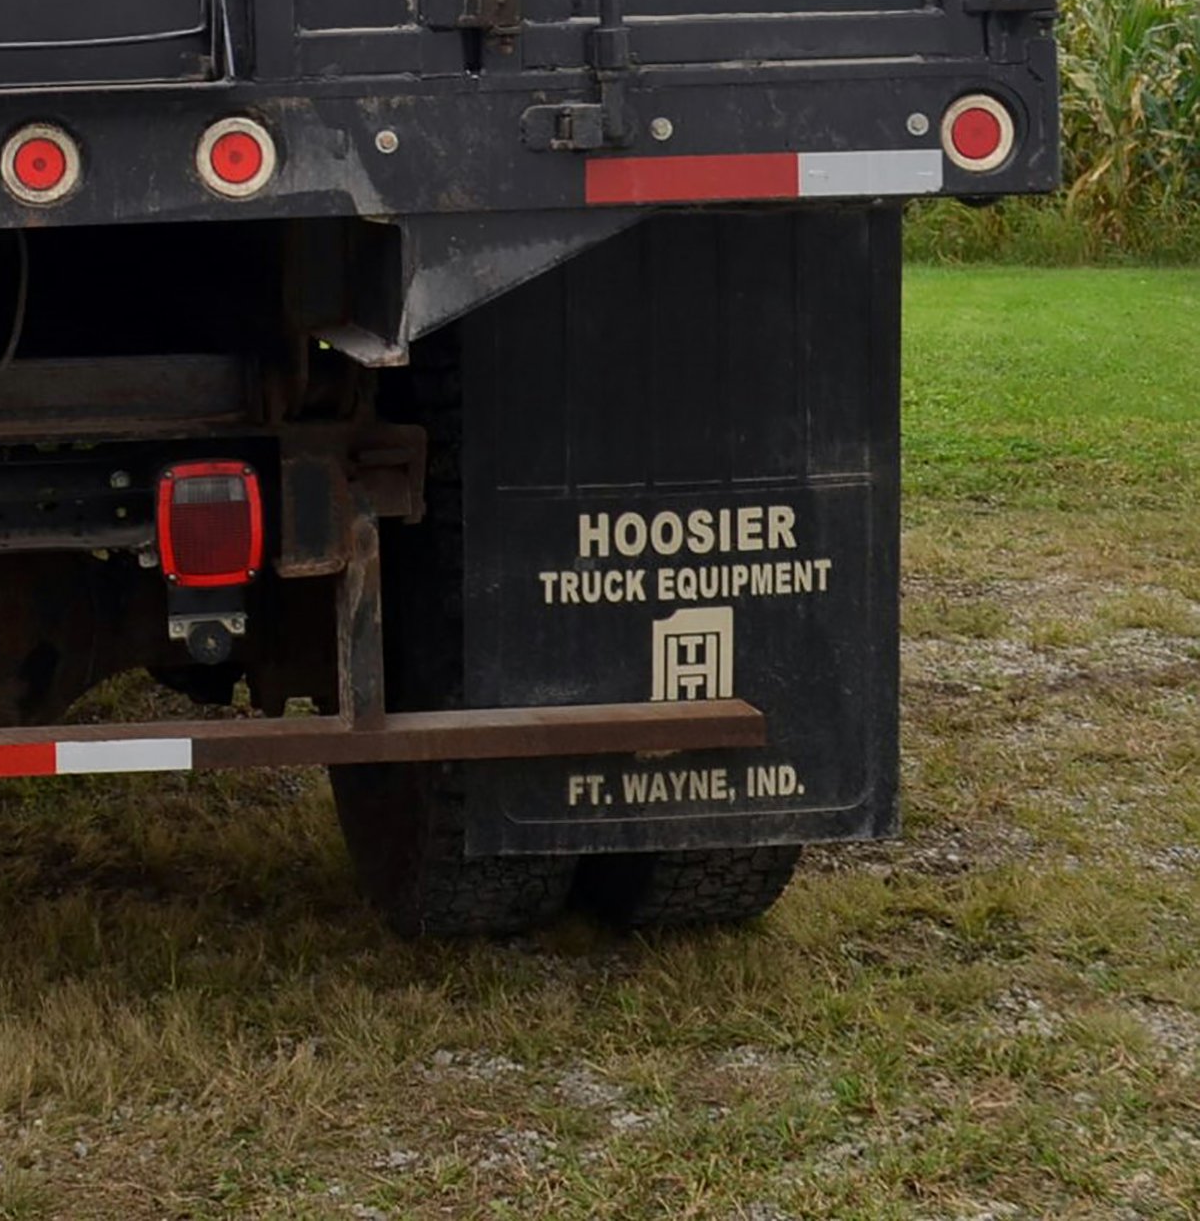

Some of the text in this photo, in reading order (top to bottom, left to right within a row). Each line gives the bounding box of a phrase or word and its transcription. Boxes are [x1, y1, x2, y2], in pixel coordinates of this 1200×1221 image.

[579, 505, 797, 557] HOOSIER
[539, 559, 832, 604] TRUCK EQUIPMENT
[568, 765, 805, 805] FT. WAYNE, IND.
